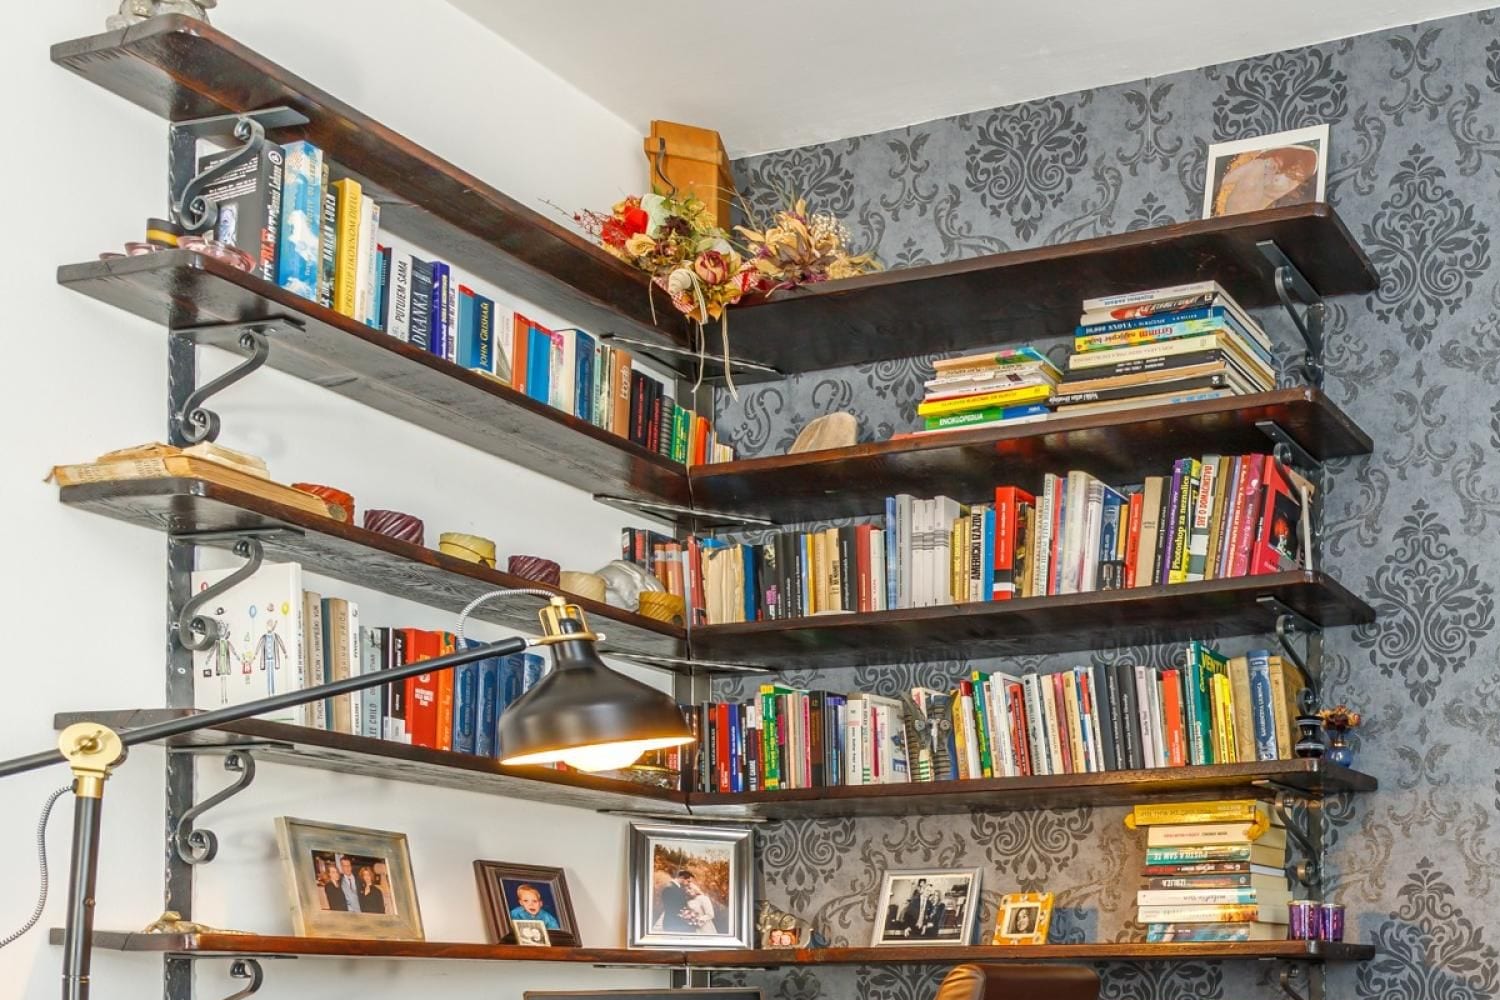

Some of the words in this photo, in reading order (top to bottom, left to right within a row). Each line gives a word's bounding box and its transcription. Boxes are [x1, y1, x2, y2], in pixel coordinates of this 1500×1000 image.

[325, 193, 336, 223] COBEN
[396, 259, 408, 285] SAMA
[394, 285, 406, 324] PUTUJEM
[479, 302, 491, 342] GRISHAM
[1138, 326, 1174, 339] Grimm
[479, 343, 489, 368] JOHN
[1179, 475, 1191, 514] neznalice
[972, 513, 982, 541] IZAZOV
[1178, 514, 1186, 525] za
[1172, 526, 1188, 570] Photoshop
[368, 703, 377, 725] CHILD
